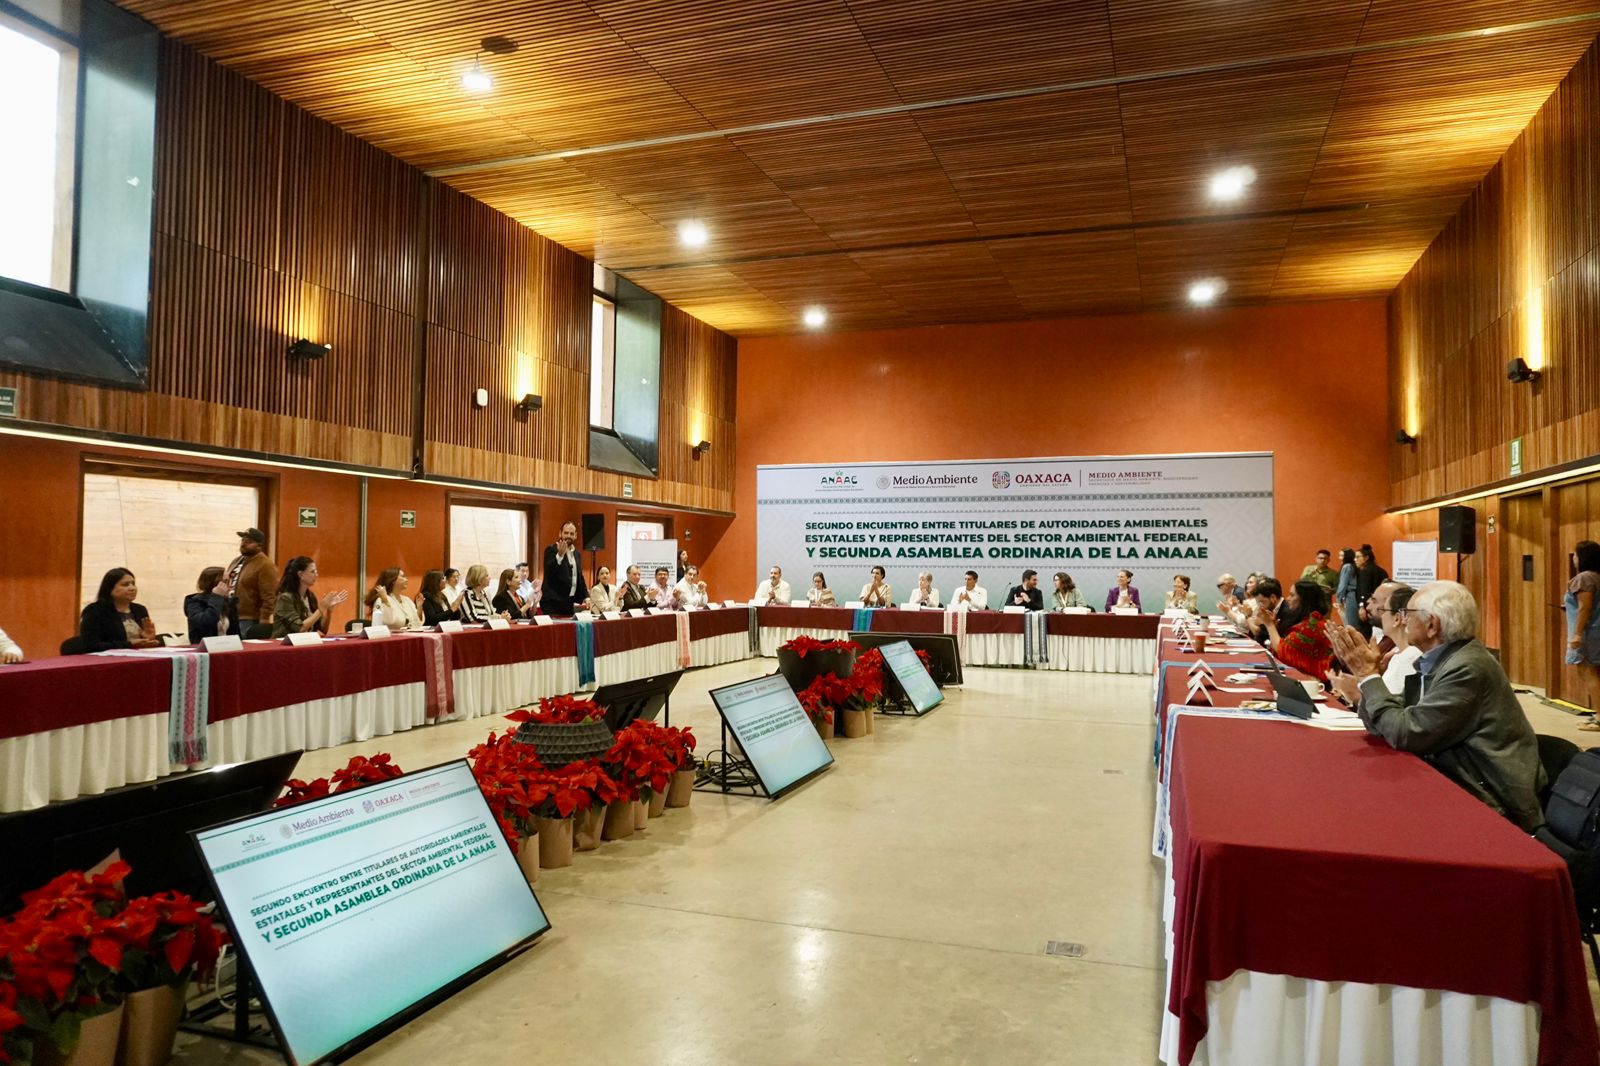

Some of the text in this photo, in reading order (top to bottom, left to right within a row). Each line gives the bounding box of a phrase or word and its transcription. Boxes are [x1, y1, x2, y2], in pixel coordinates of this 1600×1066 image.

[893, 474, 978, 485] Medio Ambiente
[1015, 473, 1072, 483] OAXACA
[1117, 470, 1163, 478] AMBIENTE
[1039, 520, 1120, 528] AUTORIDADES
[1124, 519, 1207, 527] AMBIENTALES
[880, 534, 984, 542] REPRESENTANTES
[988, 534, 1010, 542] DEL
[1014, 534, 1062, 542] SECTOR
[1066, 534, 1140, 542] AMBIENTAL
[1144, 533, 1207, 543] FEDERAL,
[806, 547, 1207, 558] Y SEGUNDA ASAMBLEA ORDINARIA DE LA ANAAE
[374, 793, 404, 807] OAXACA
[291, 807, 355, 832] Medio Ambiente
[250, 822, 487, 917] SEGUNDO ENCUENTRO ENTRE TITULARES DE AUTORIDADES AMBIENTALES
[255, 903, 307, 930] ESTATALES
[307, 900, 313, 909] Y
[315, 872, 385, 906] REPRESENTANTES
[385, 867, 400, 879] DEL
[400, 856, 427, 872] SECTOR
[427, 844, 463, 862] AMBIENTAL
[261, 840, 497, 943] Y SEGUNDA ASAMBLEA ORDINARIA DE LA ANAAE
